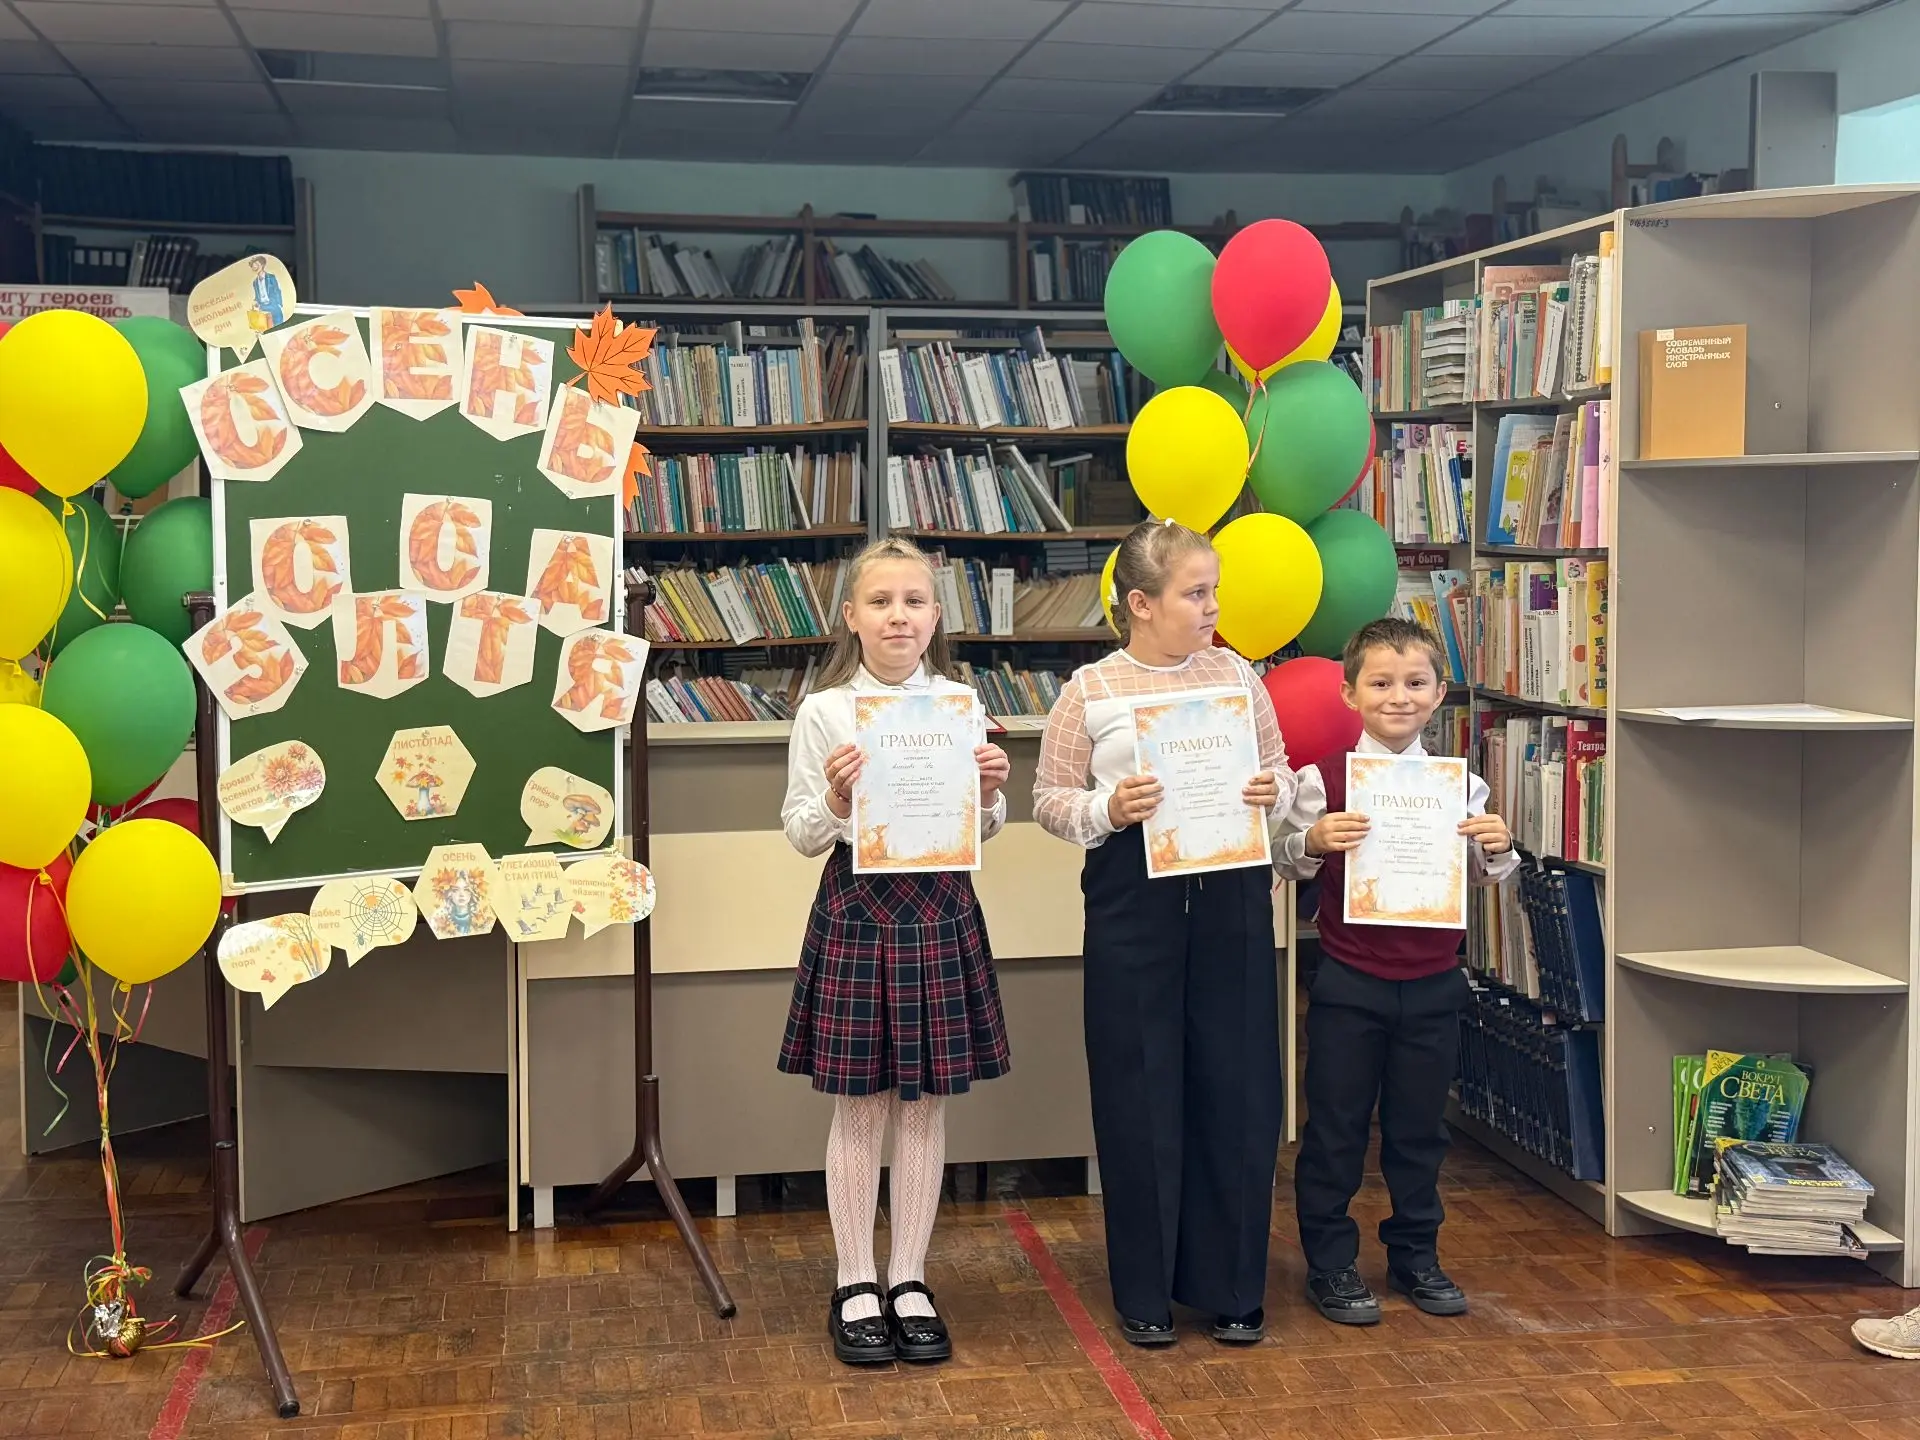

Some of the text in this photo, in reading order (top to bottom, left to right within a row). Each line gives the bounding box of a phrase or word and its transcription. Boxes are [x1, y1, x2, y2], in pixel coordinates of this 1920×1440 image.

[40, 291, 114, 307] героев
[214, 320, 232, 334] дни
[1665, 337, 1732, 347] СОВРЕМЕННЫЙ
[1665, 346, 1705, 355] СЛОВАРЬ
[1665, 352, 1731, 361] ИНОСТРАННЫХ
[1397, 551, 1444, 567] очу быть
[393, 735, 453, 750] ЛИСТОПАД
[880, 733, 953, 748] ГРАМОТА
[1160, 735, 1233, 755] ГРАМОТА
[1577, 741, 1606, 752] Театра
[221, 784, 261, 804] осенних
[528, 779, 560, 801] Грибная
[229, 796, 264, 814] цветов
[529, 795, 550, 809] пора
[1372, 794, 1443, 809] ГРАМОТА
[442, 851, 476, 863] ОСЕНЬ
[500, 858, 560, 870] УЛЕТАЮЩИЕ
[504, 870, 559, 882] СТАИ ПТИЦ
[231, 959, 256, 970] пора
[1741, 1070, 1781, 1085] ВОКРУГ
[1720, 1076, 1786, 1106] СВЕТА
